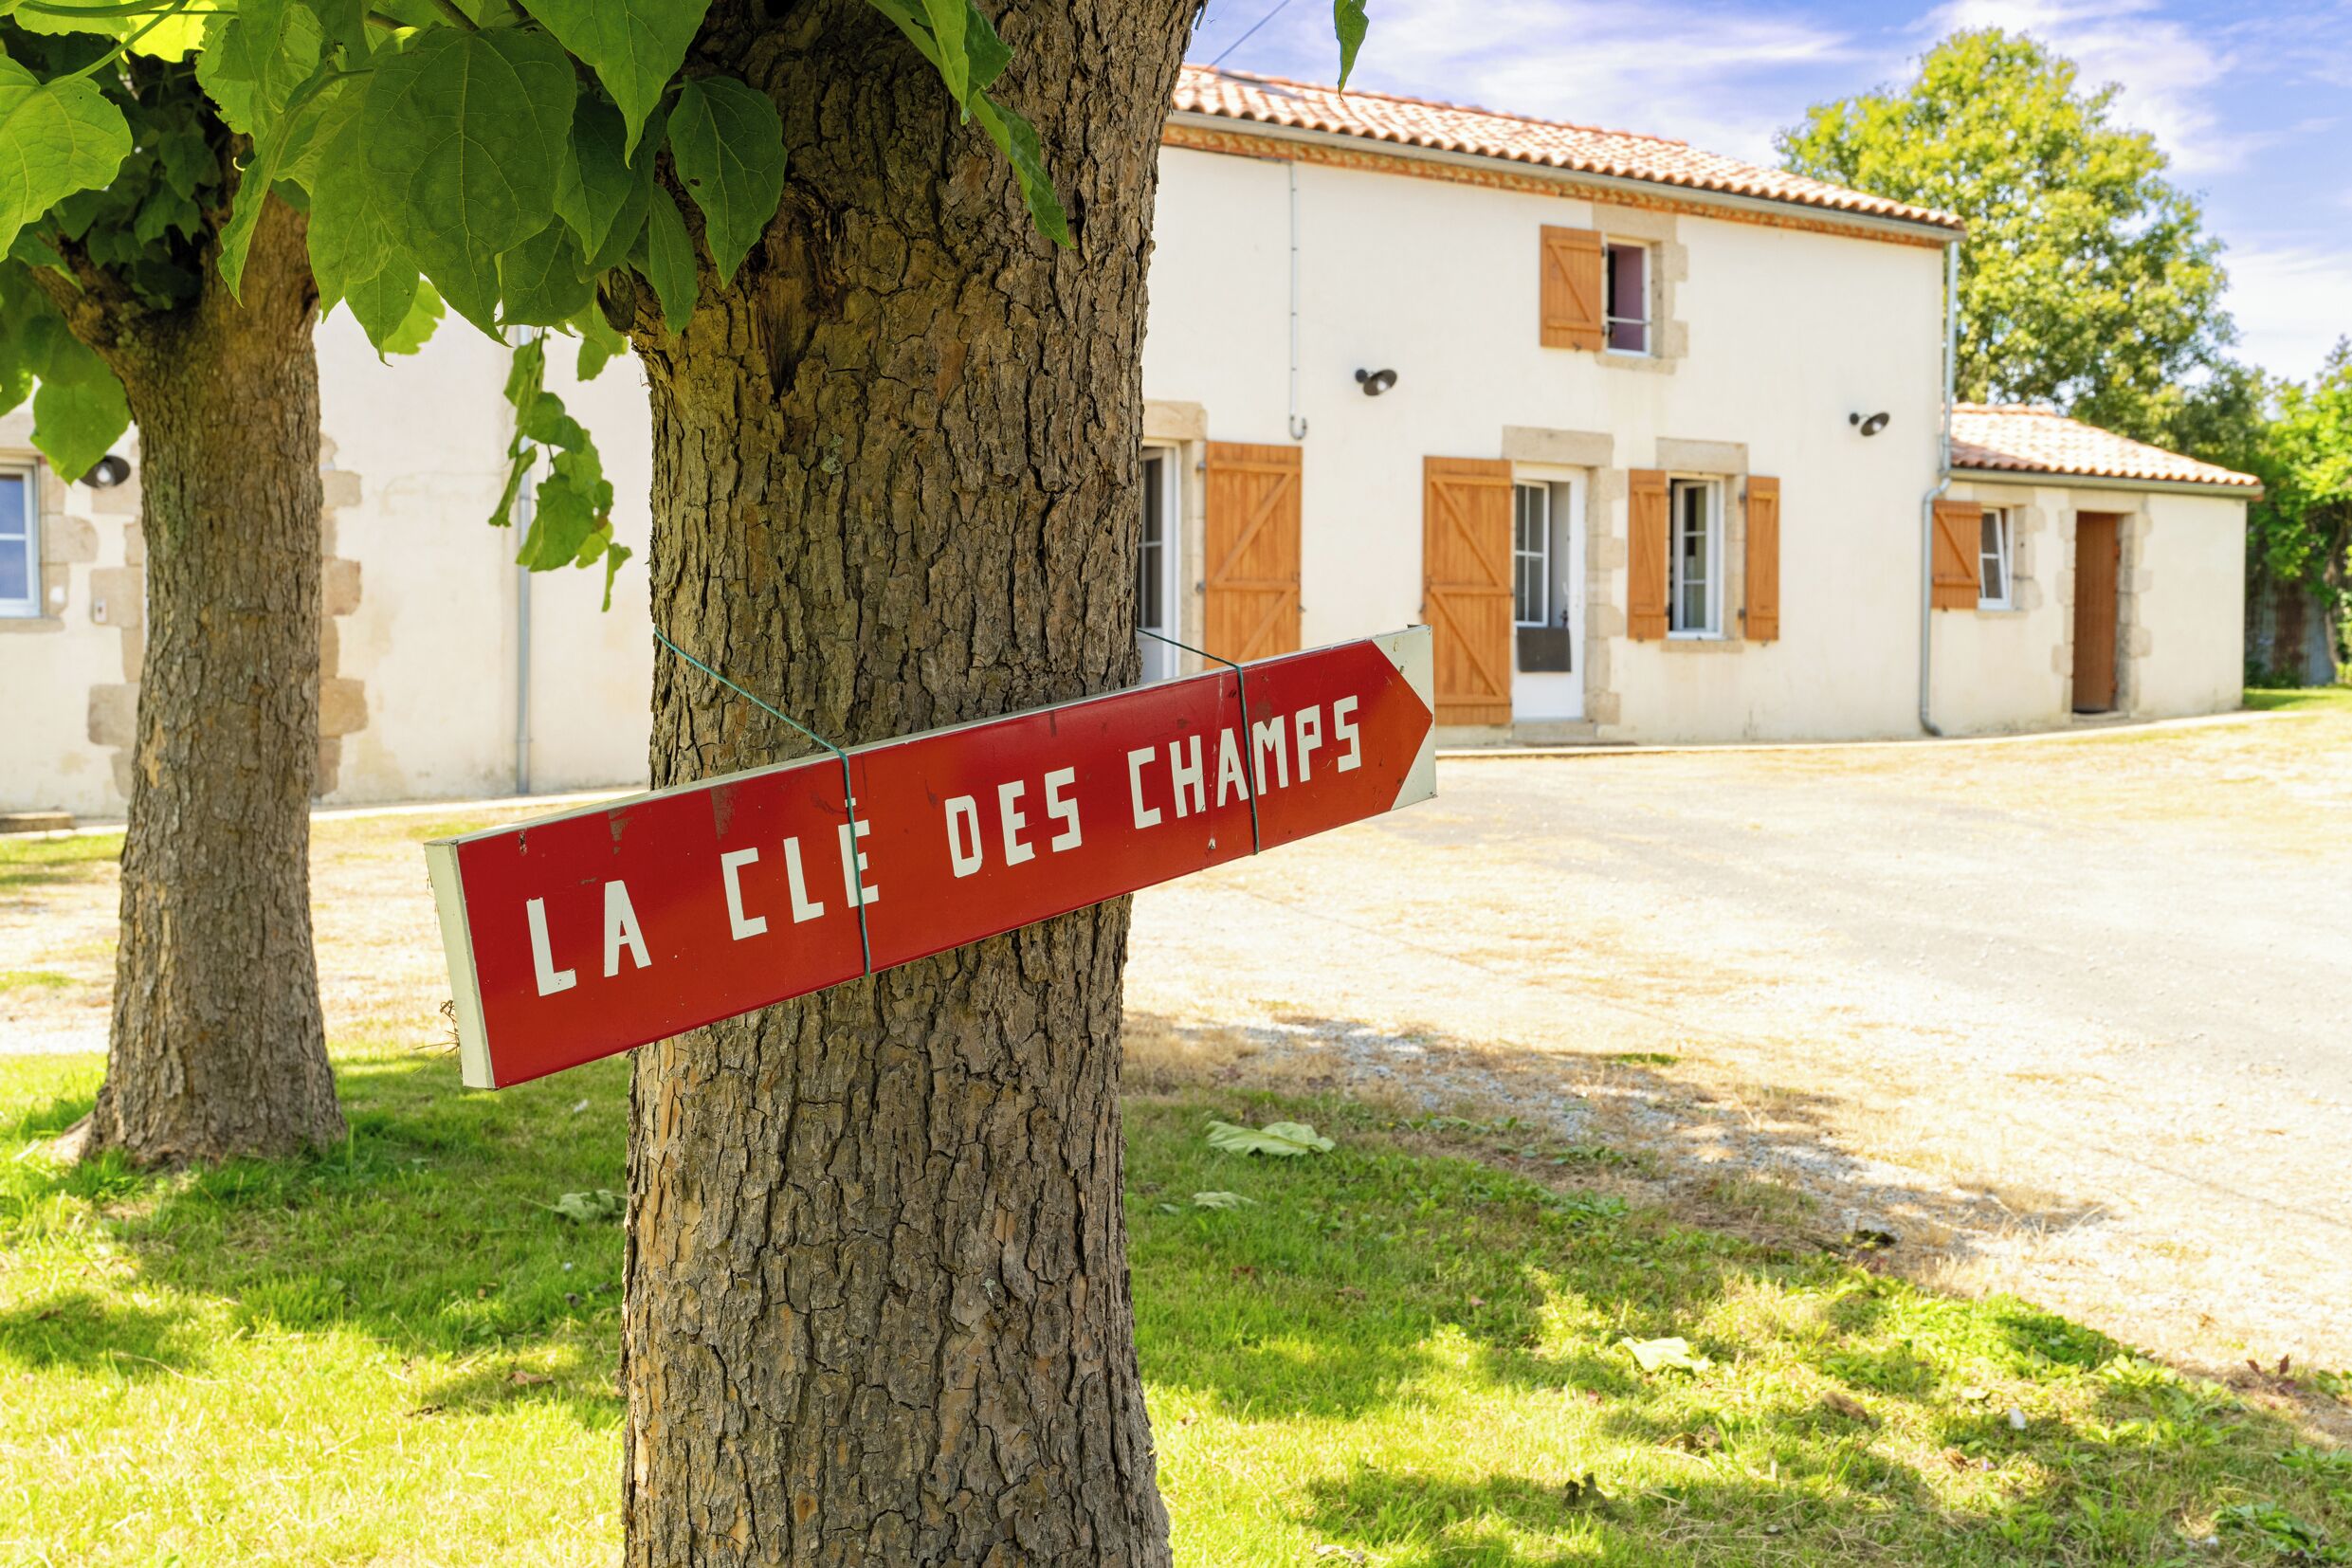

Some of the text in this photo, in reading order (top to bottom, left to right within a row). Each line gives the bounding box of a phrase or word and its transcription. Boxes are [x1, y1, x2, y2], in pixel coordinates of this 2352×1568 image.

[525, 879, 653, 997] LA
[943, 765, 1084, 880] DES
[1126, 694, 1362, 830] CHAMPS
